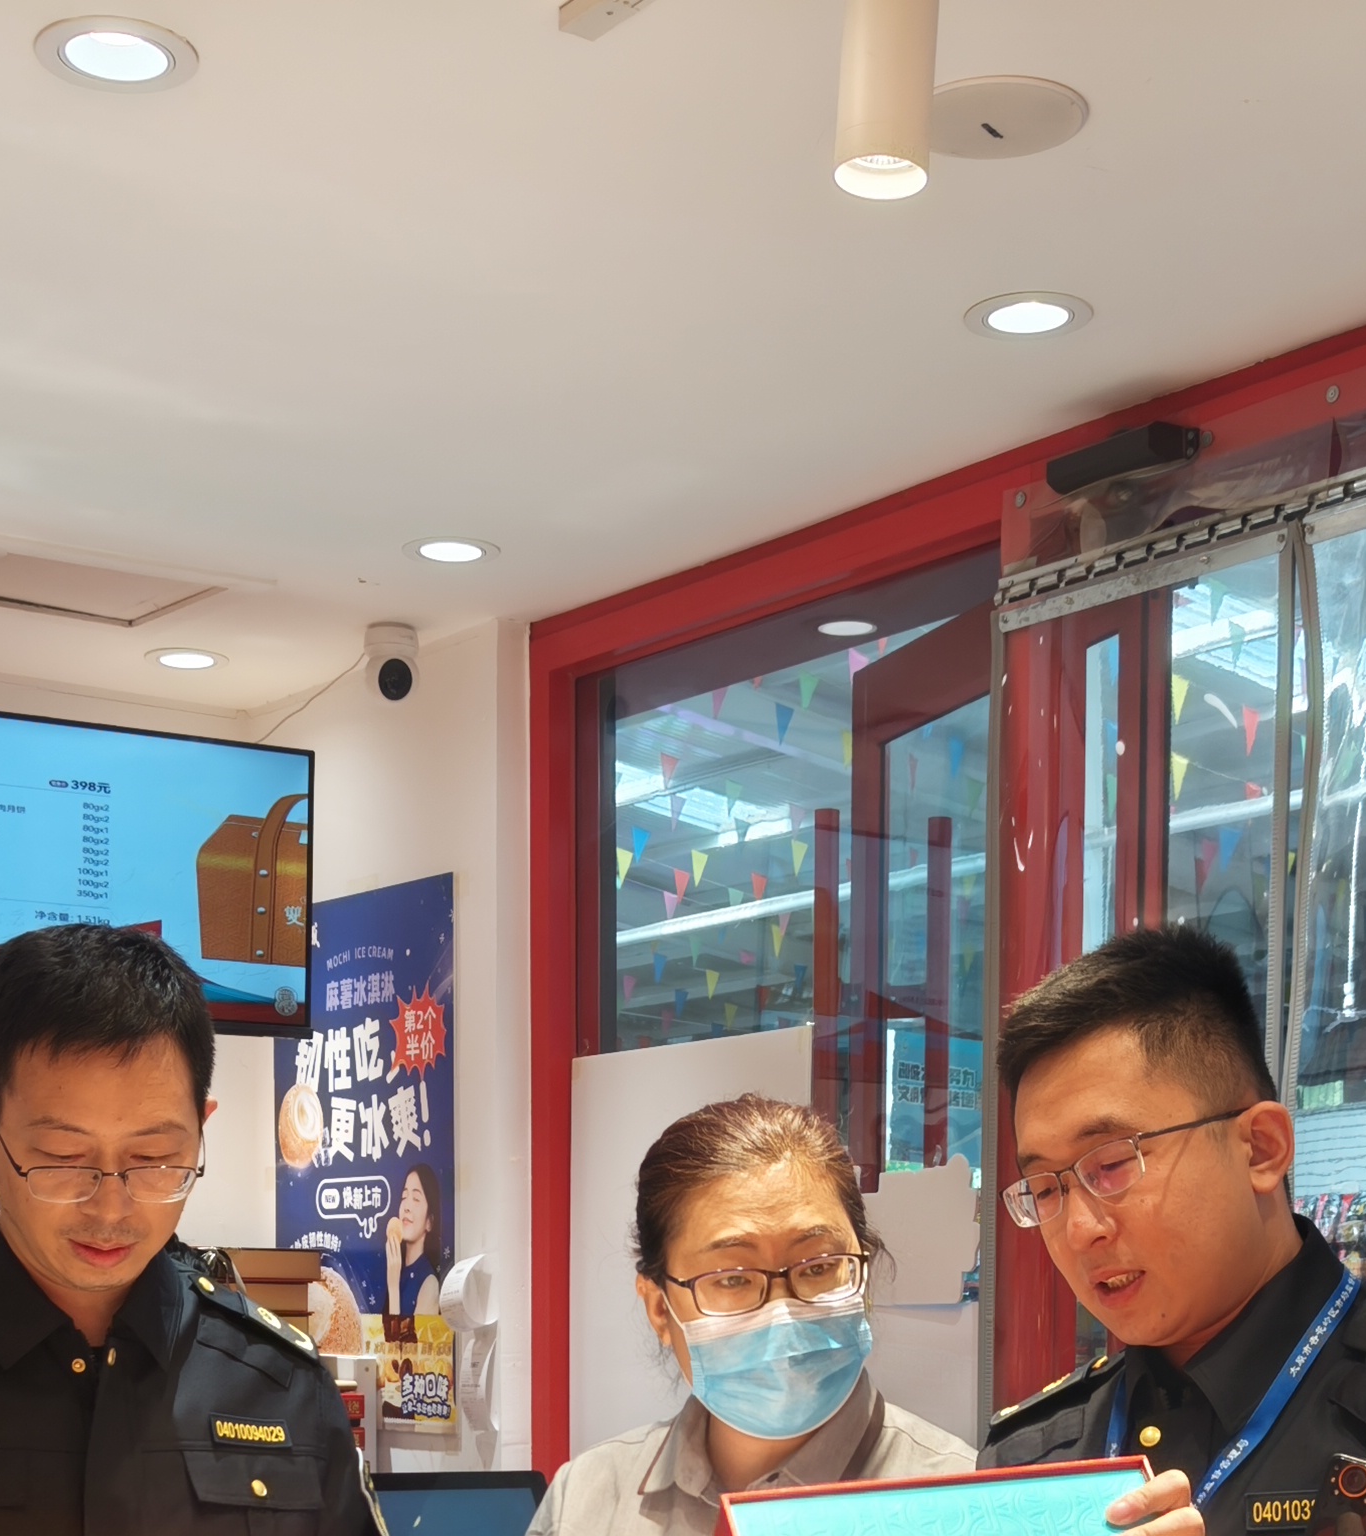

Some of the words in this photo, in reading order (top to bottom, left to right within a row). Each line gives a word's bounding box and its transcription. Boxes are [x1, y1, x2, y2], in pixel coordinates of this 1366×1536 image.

[71, 780, 111, 794] 398元
[326, 950, 351, 972] MOCHI
[354, 946, 366, 959] ICE
[368, 945, 394, 962] CREAM
[325, 970, 395, 1012] 麻薯冰淇淋
[403, 1006, 436, 1034] 第2个
[404, 1036, 436, 1062] 半价
[323, 1194, 337, 1206] NEW
[1252, 1499, 1316, 1524] 040103
